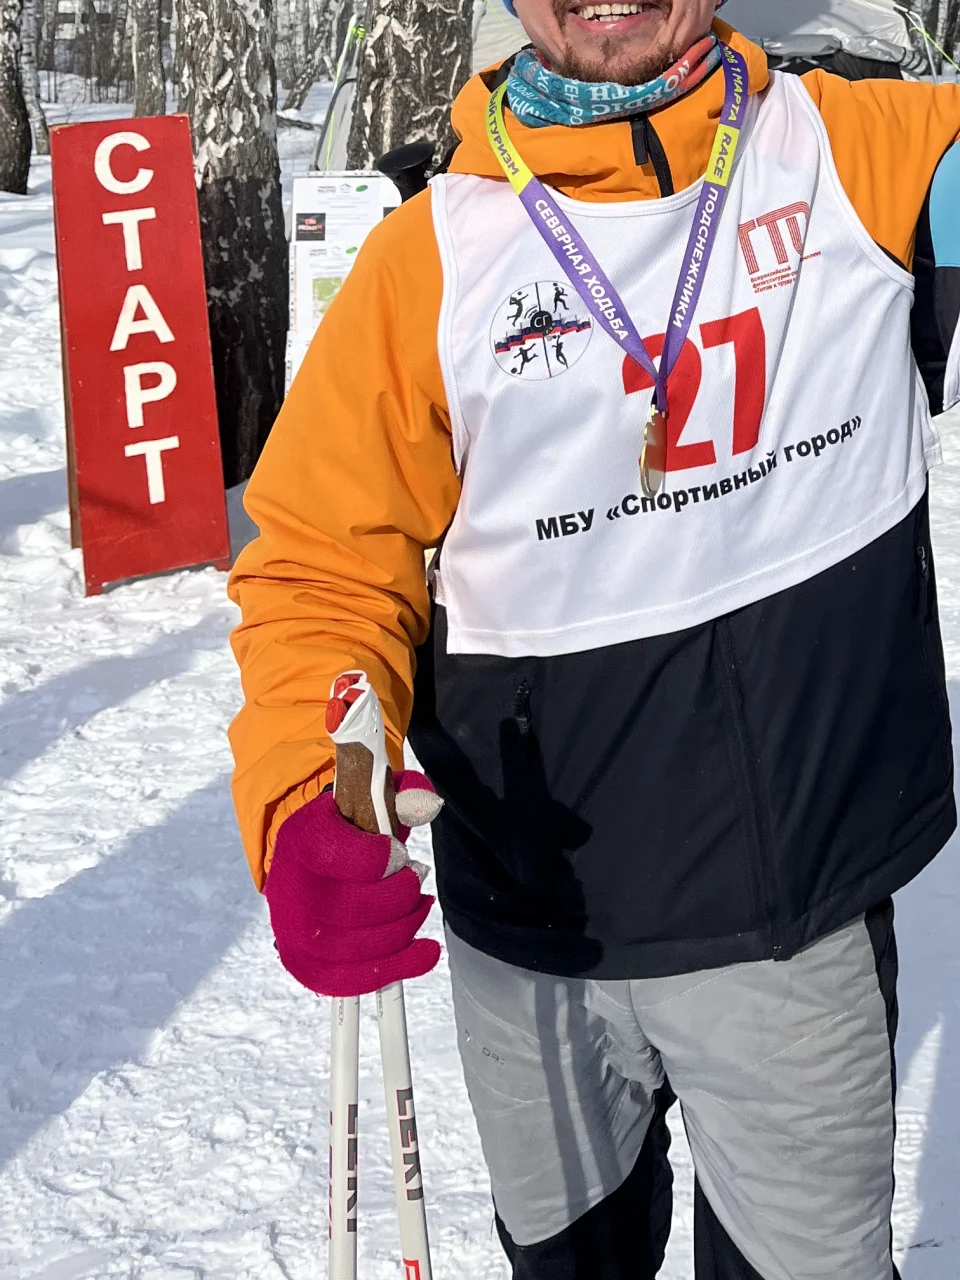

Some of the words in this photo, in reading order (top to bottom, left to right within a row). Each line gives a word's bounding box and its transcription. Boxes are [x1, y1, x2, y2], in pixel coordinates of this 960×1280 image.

[489, 116, 521, 176] ТУРИЗМ
[713, 132, 732, 180] RACE
[728, 72, 744, 122] МАРТА
[93, 131, 180, 505] СТАРТ
[534, 198, 592, 276] СЕВЕРНАЯ
[582, 272, 630, 341] ХОДЬБА
[672, 186, 719, 329] ПОДСНЕЖНИКИ
[622, 307, 766, 474] 27
[535, 508, 595, 541] МБУ
[606, 450, 778, 521] «Спортивный
[783, 415, 863, 462] город»
[396, 1087, 424, 1201] LEKI
